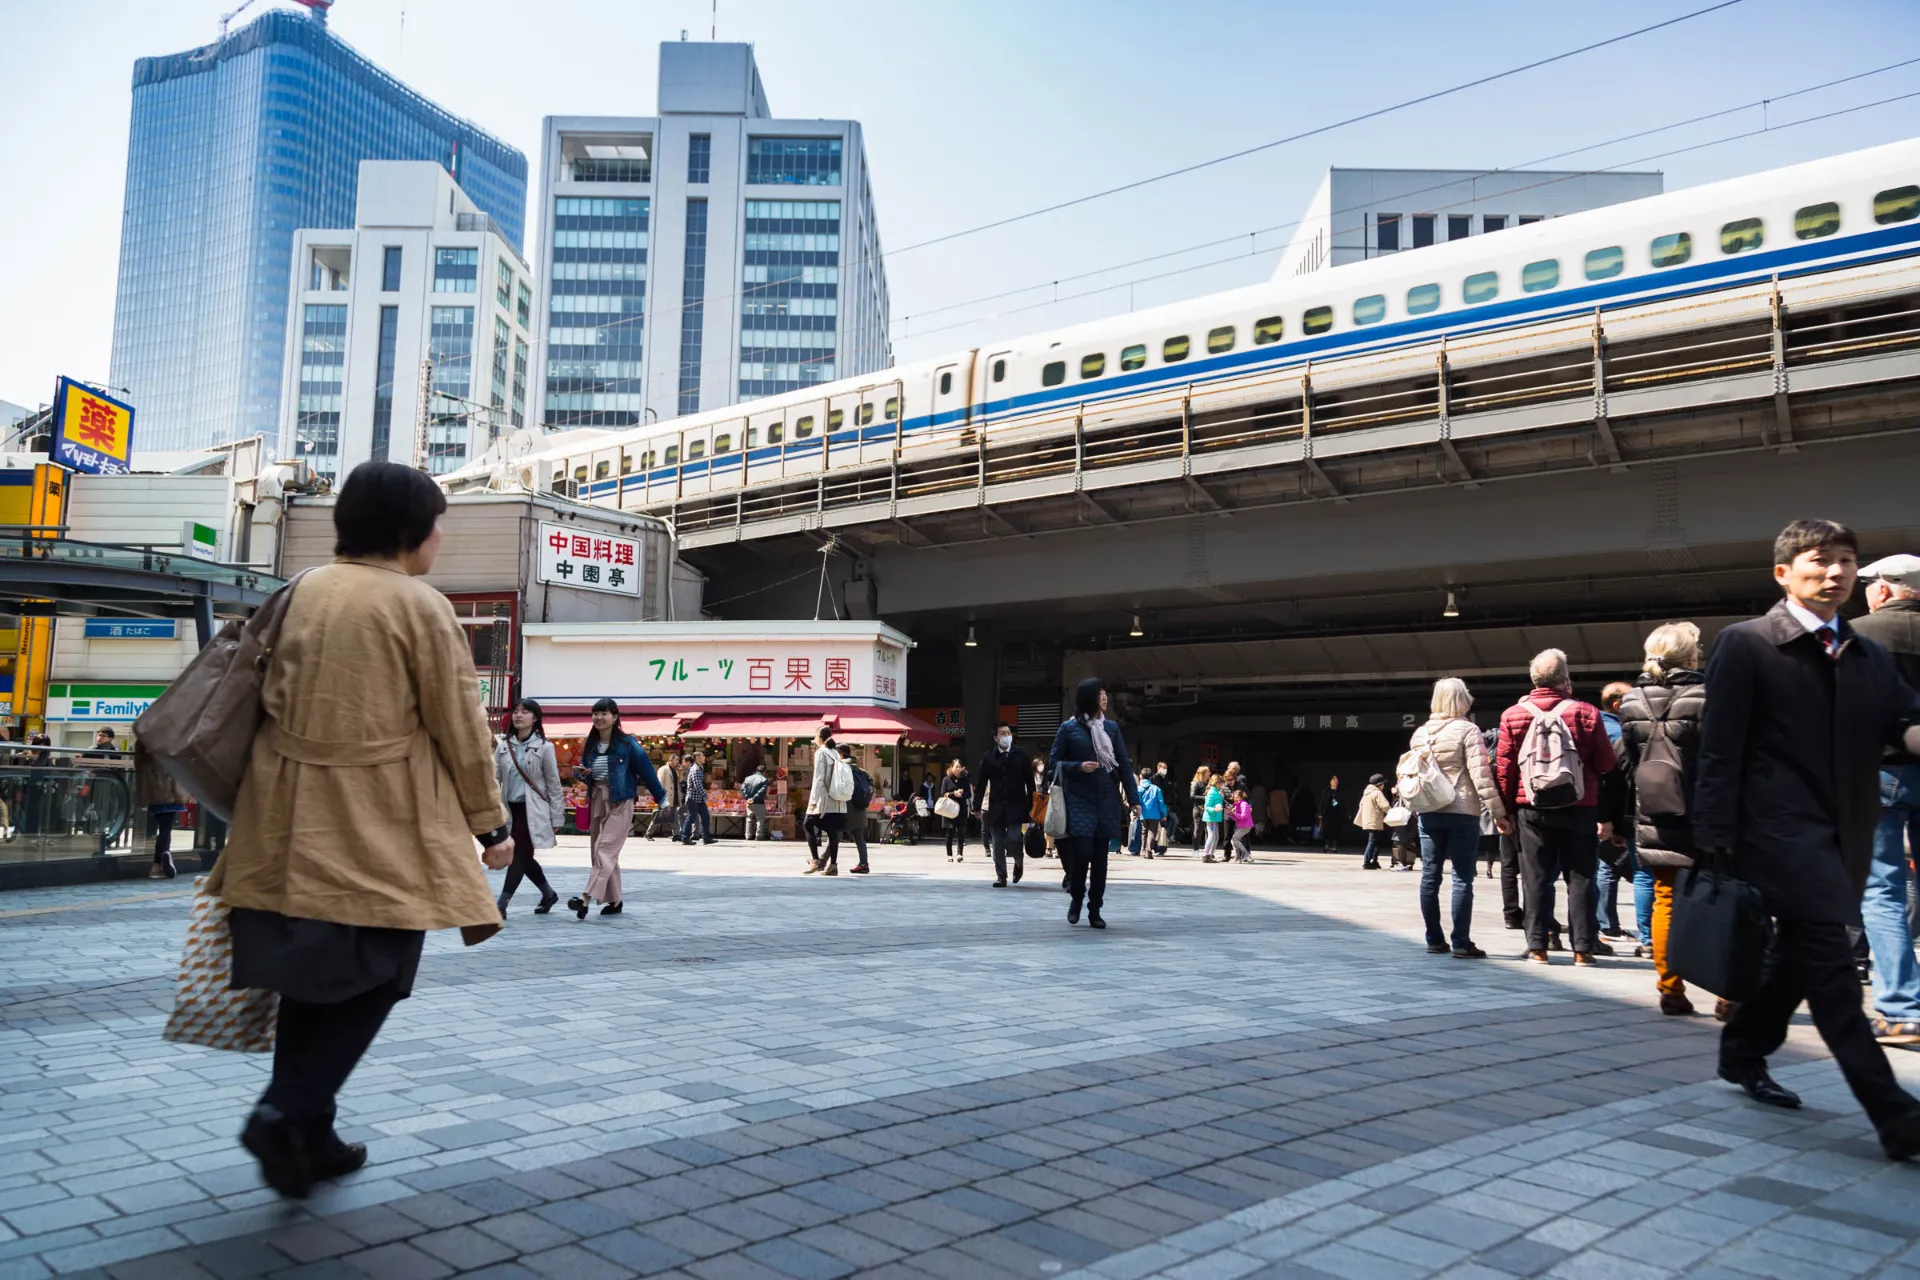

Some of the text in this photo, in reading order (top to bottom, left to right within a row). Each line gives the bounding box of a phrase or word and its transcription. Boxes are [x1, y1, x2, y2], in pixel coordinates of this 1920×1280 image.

[79, 397, 116, 451] 薬
[48, 481, 61, 497] 薬
[549, 531, 635, 566] 中国料理
[556, 559, 625, 587] 中園亭
[649, 657, 851, 692] フルーツ 百果園
[876, 675, 896, 696] 百果園
